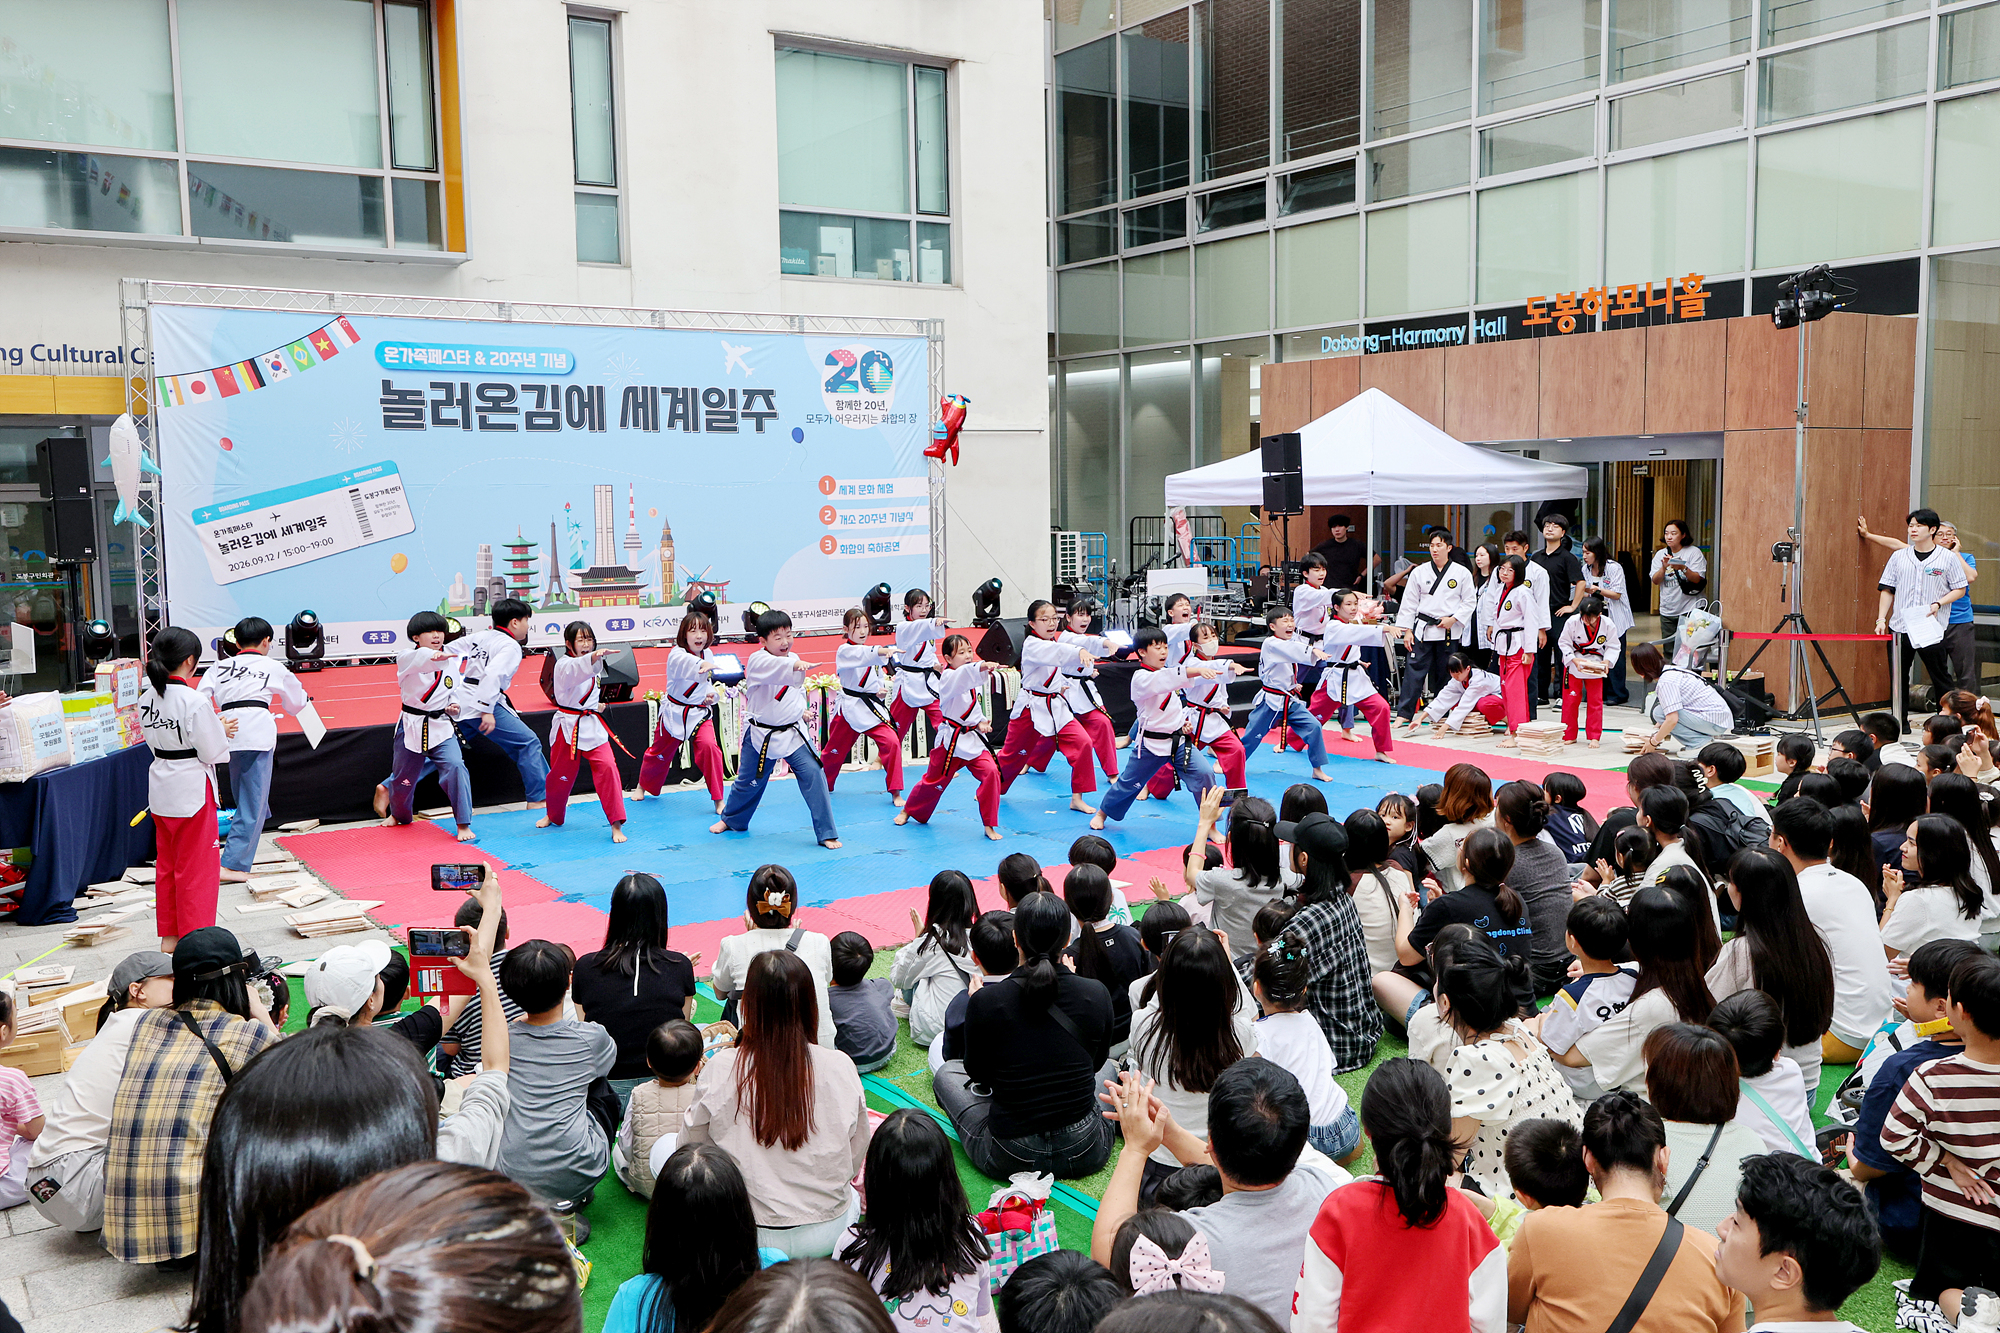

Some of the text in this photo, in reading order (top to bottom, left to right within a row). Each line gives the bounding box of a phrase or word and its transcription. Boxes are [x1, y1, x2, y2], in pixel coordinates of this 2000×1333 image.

[781, 257, 805, 265] makita
[1523, 273, 1711, 333] 도봉하모니홀
[1321, 316, 1507, 353] Dobong-Harmony Hall
[30, 344, 124, 364] Cultural
[384, 346, 567, 369] 온가족페스타 & 20주년 기념
[824, 348, 894, 394] 20
[379, 378, 779, 434] 놀러온김에 세계일주
[835, 399, 889, 412] 함께한 20년,
[805, 413, 918, 425] 모두가 어우러지는 화합의 장
[824, 480, 830, 491] 1
[839, 485, 856, 495] 세계
[858, 484, 875, 495] 문화
[218, 502, 239, 512] BOARDING
[824, 510, 832, 521] 2
[839, 511, 914, 525] 개소 20주년 기념식
[213, 521, 254, 538] 온가족페스타
[217, 515, 328, 555] 놀러온김에 세계일주
[825, 540, 833, 551] 3
[840, 541, 900, 555] 화합의 축하공연
[228, 553, 276, 572] 2026.09.12
[283, 536, 334, 557] 15:00-19:00
[16, 572, 54, 580] 도봉구민회관
[791, 608, 846, 619] 도봉구시설관리공단
[611, 620, 630, 630] 후원
[369, 632, 390, 643] 주관
